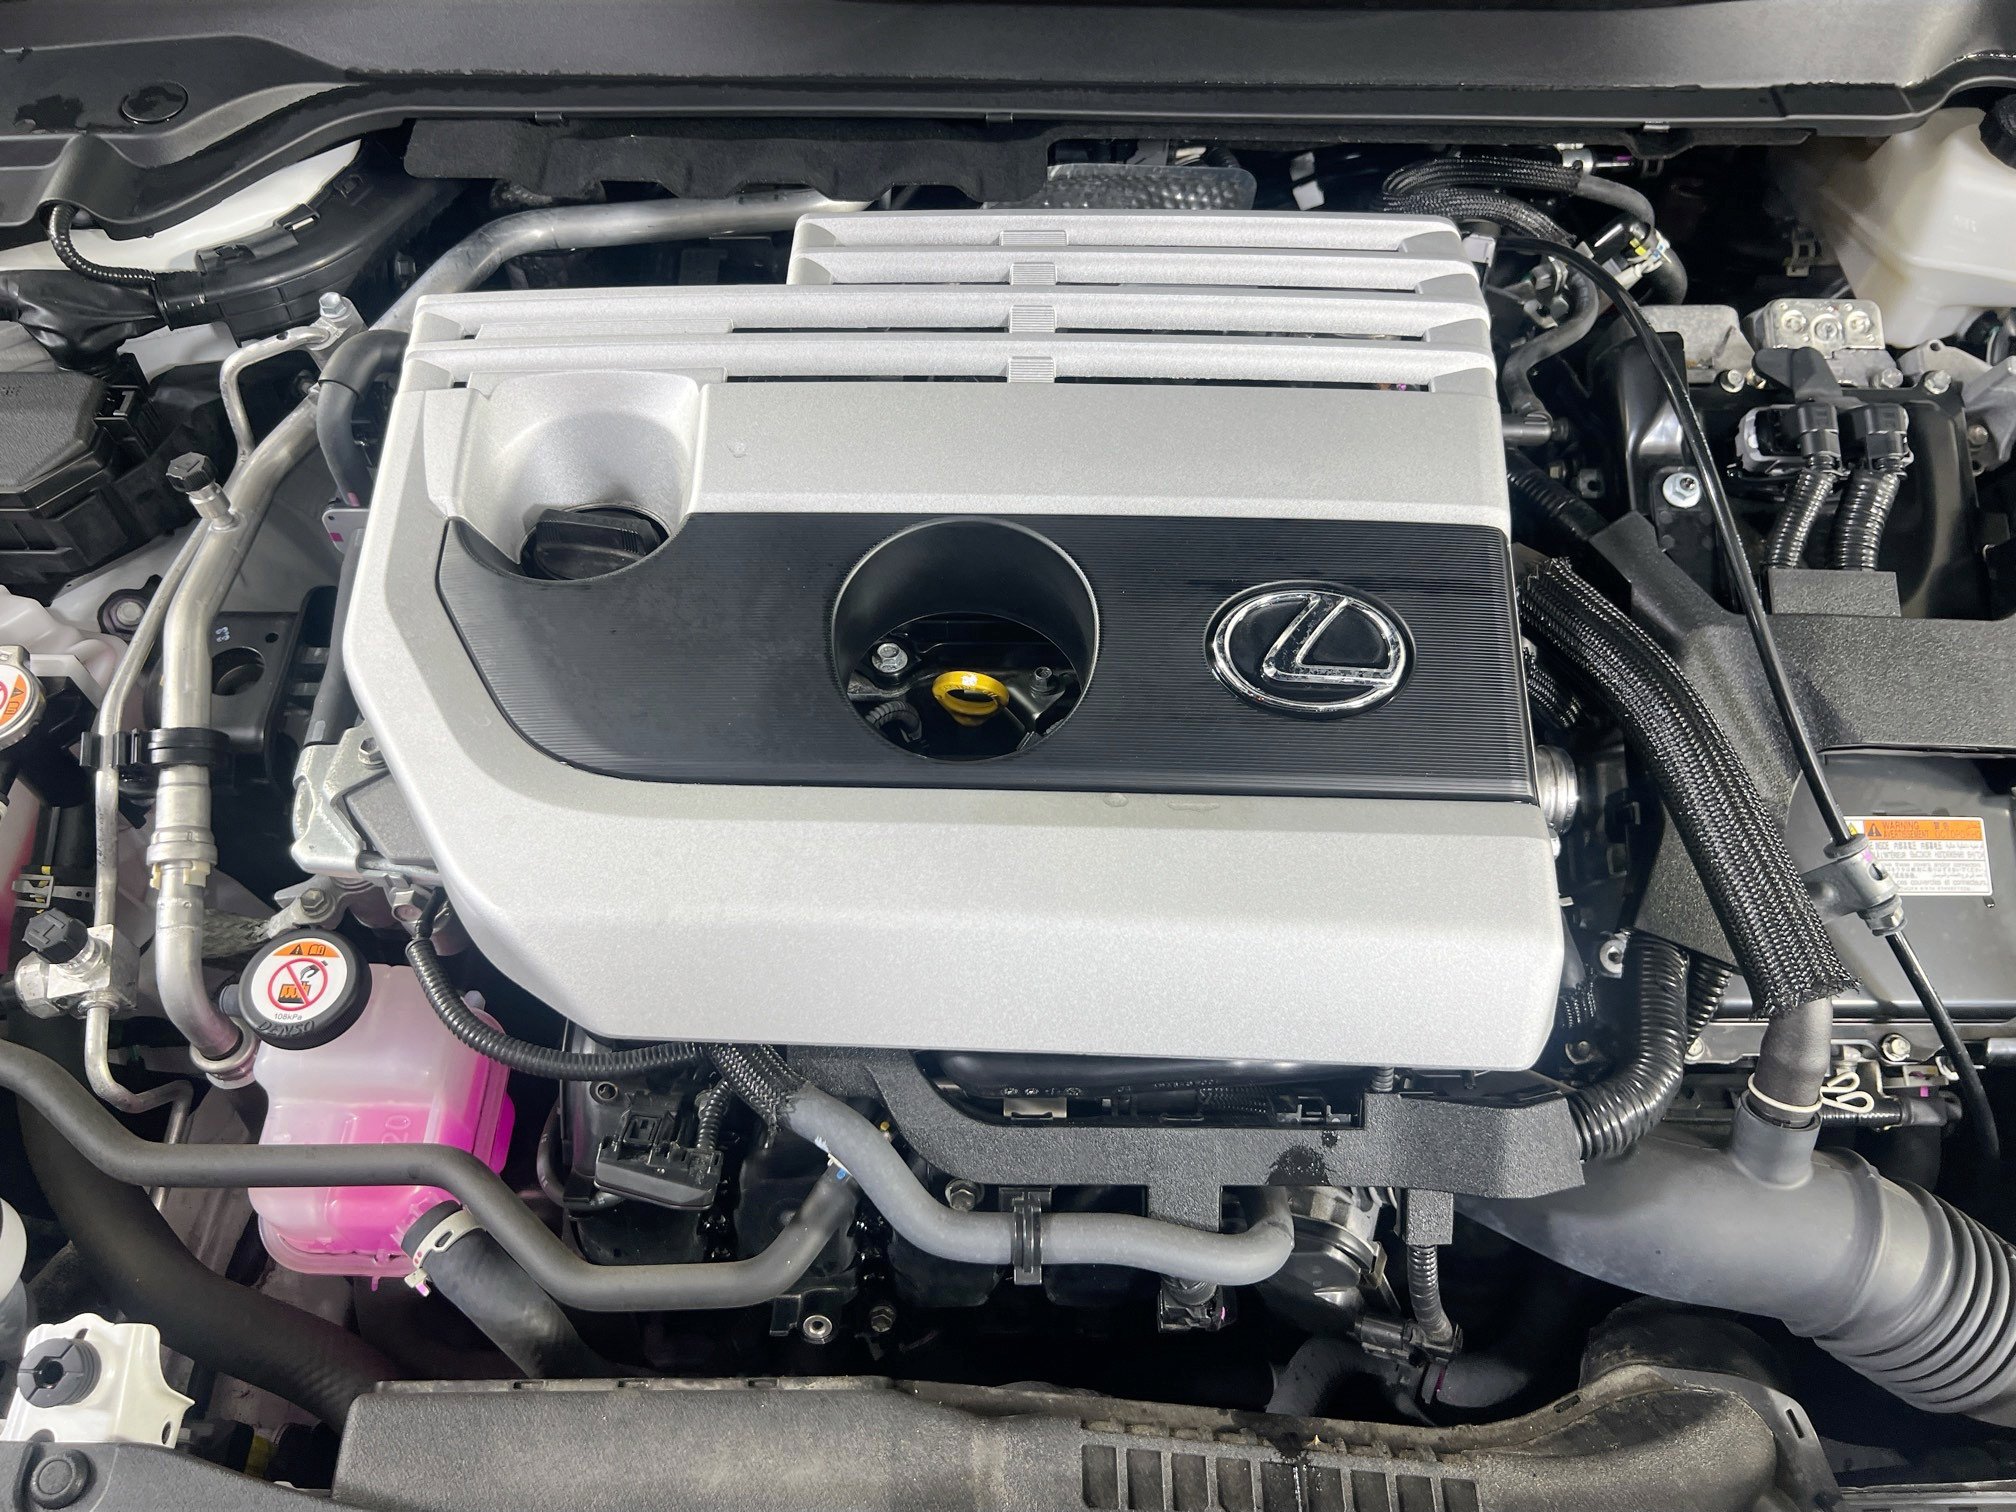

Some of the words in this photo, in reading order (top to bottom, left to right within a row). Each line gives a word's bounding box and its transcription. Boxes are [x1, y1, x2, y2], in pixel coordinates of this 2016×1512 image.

[1883, 820, 1919, 830] WARNING
[274, 1013, 302, 1021] 108kPa
[256, 1020, 315, 1036] DENSO
